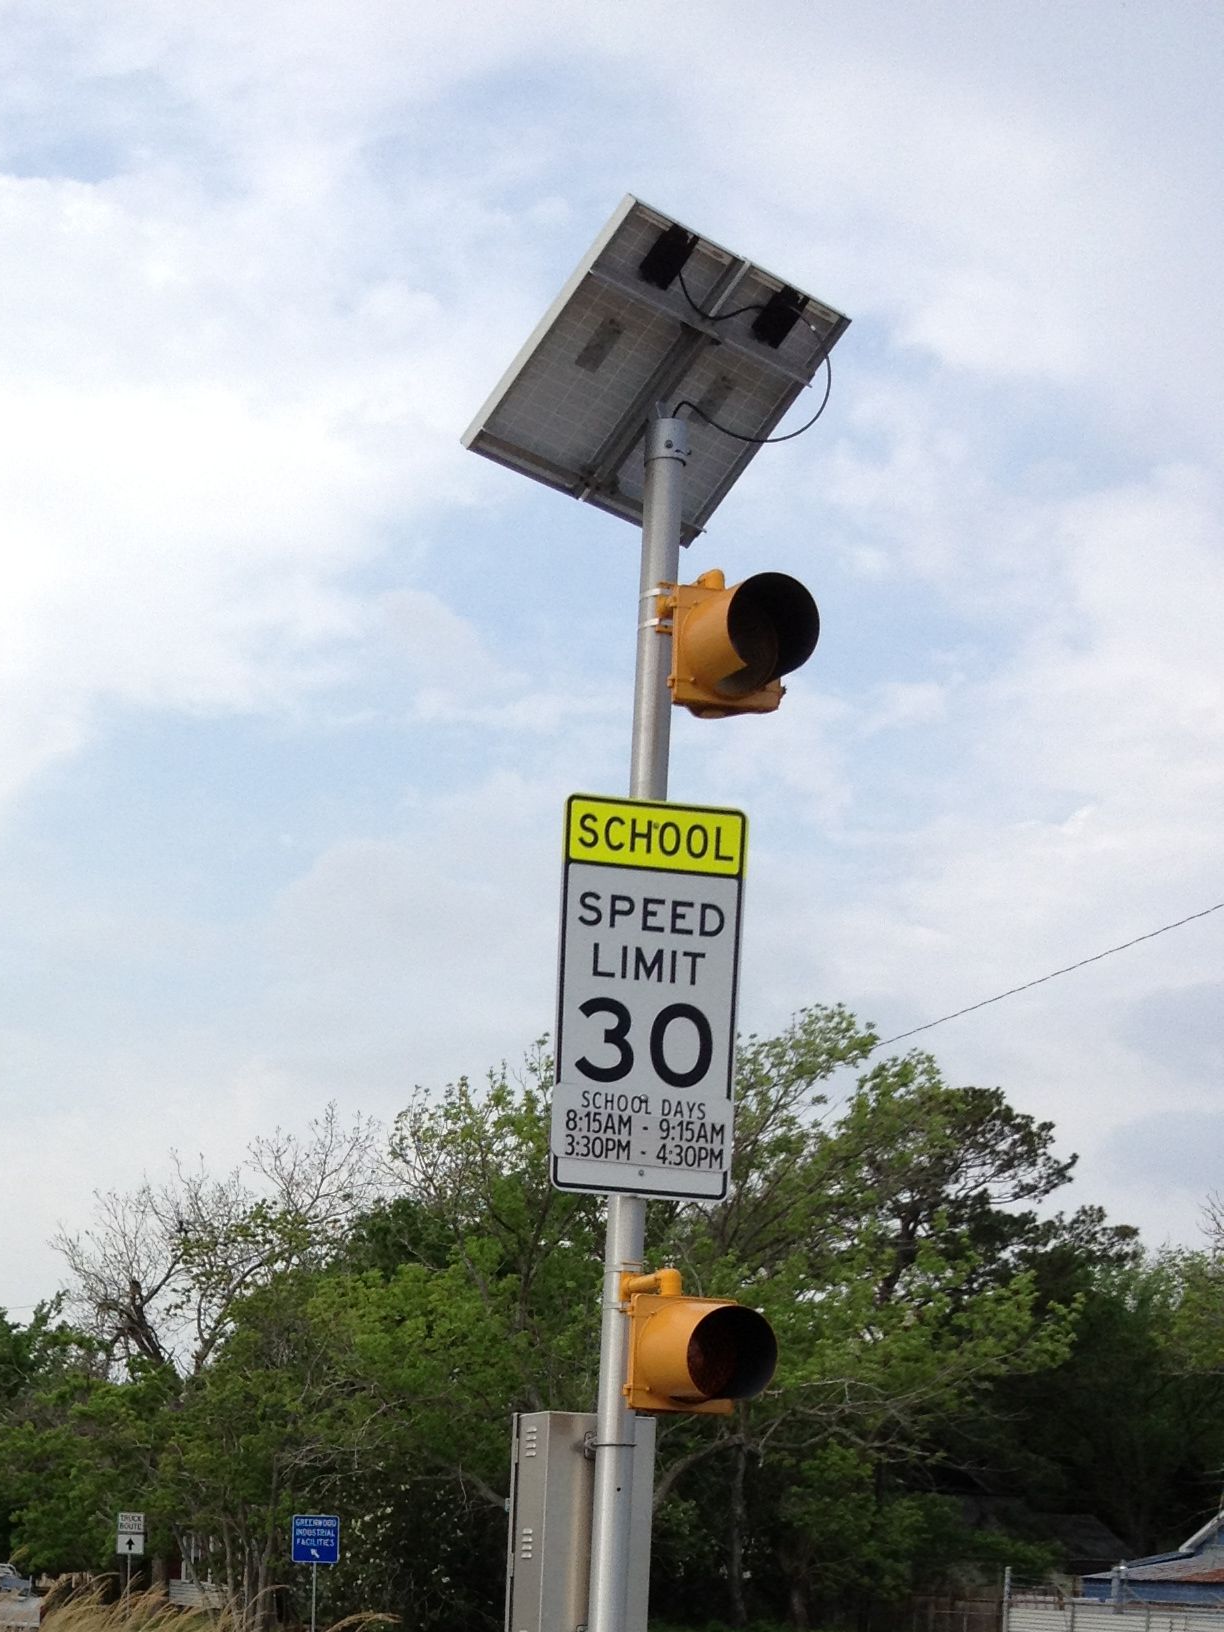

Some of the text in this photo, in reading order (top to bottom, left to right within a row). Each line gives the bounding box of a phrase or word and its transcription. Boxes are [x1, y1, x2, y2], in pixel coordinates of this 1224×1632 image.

[578, 812, 734, 862] SCHOOL
[578, 891, 725, 937] SPEED
[592, 942, 706, 985] LIMIT
[575, 996, 713, 1088] 30
[581, 1090, 706, 1120] SCHOOL DAYS
[565, 1109, 632, 1136] 8:15AM
[659, 1118, 725, 1145] 9:15AM
[564, 1134, 631, 1161] 3:30PM
[656, 1143, 723, 1170] 4:30PM
[295, 1528, 336, 1537] INDUSTRIAL
[296, 1538, 335, 1547] FACILITIES
